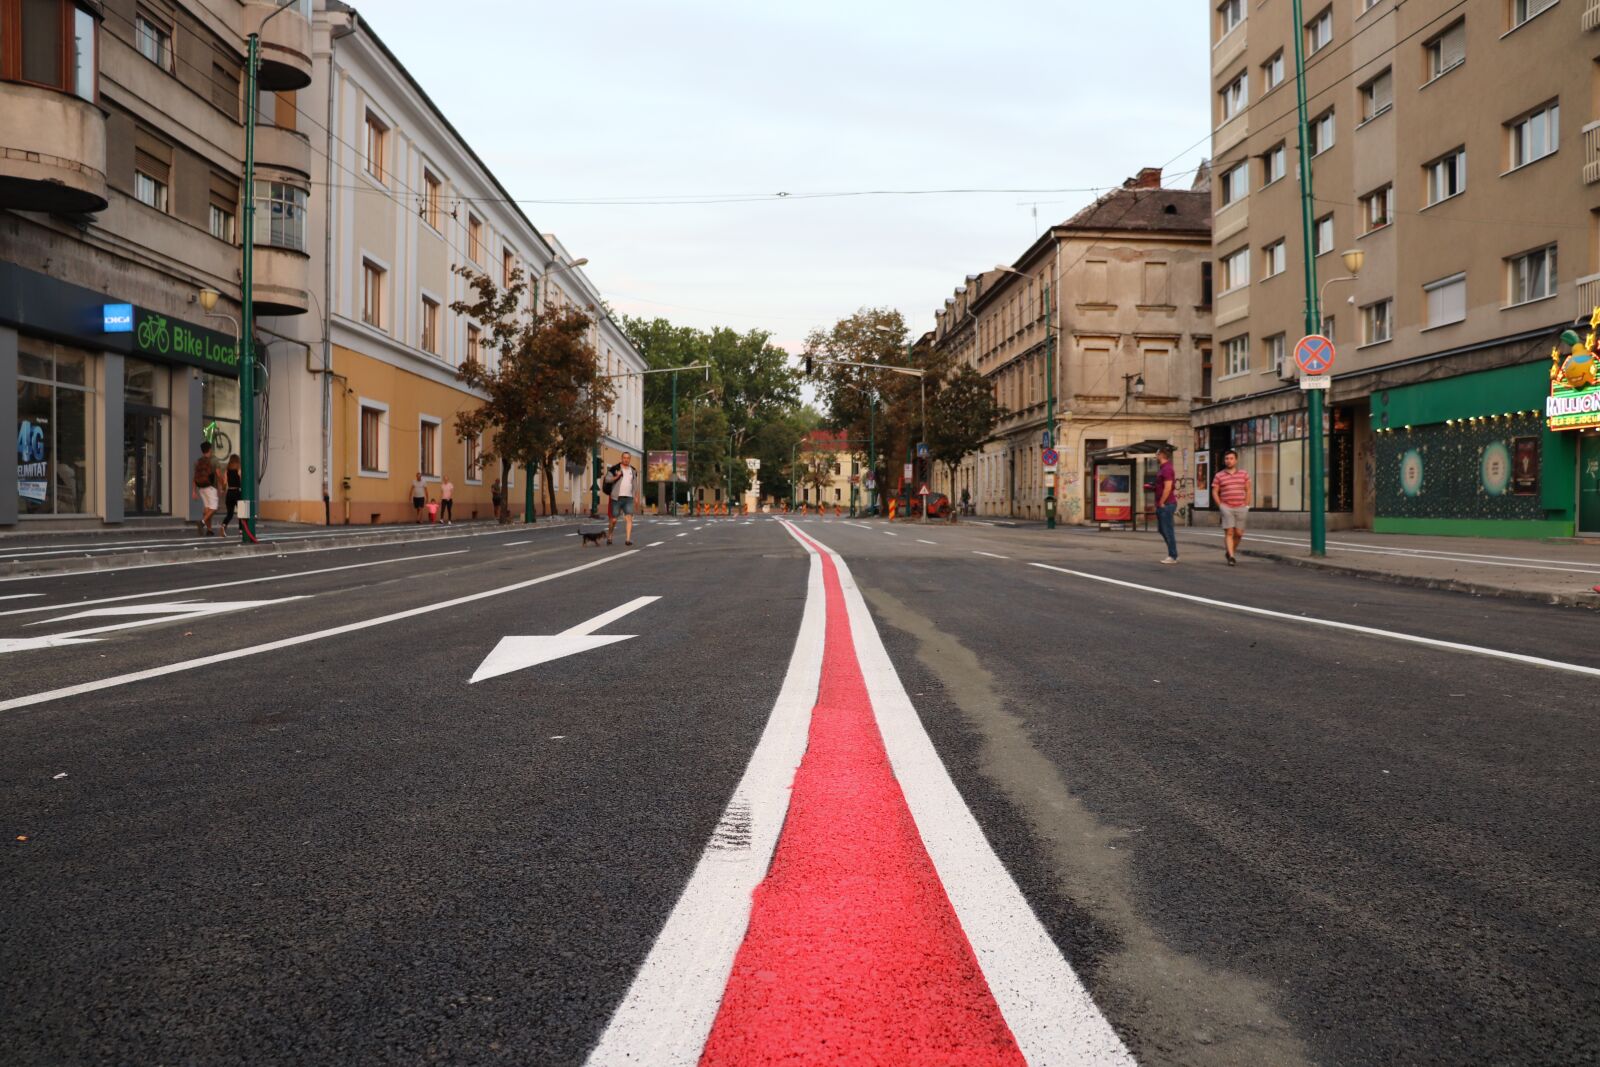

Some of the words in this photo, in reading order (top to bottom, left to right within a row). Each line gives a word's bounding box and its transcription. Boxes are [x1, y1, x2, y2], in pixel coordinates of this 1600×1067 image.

[104, 315, 130, 324] DIGI
[173, 326, 203, 357] Bike
[205, 336, 238, 366] Local
[17, 419, 44, 462] 4G
